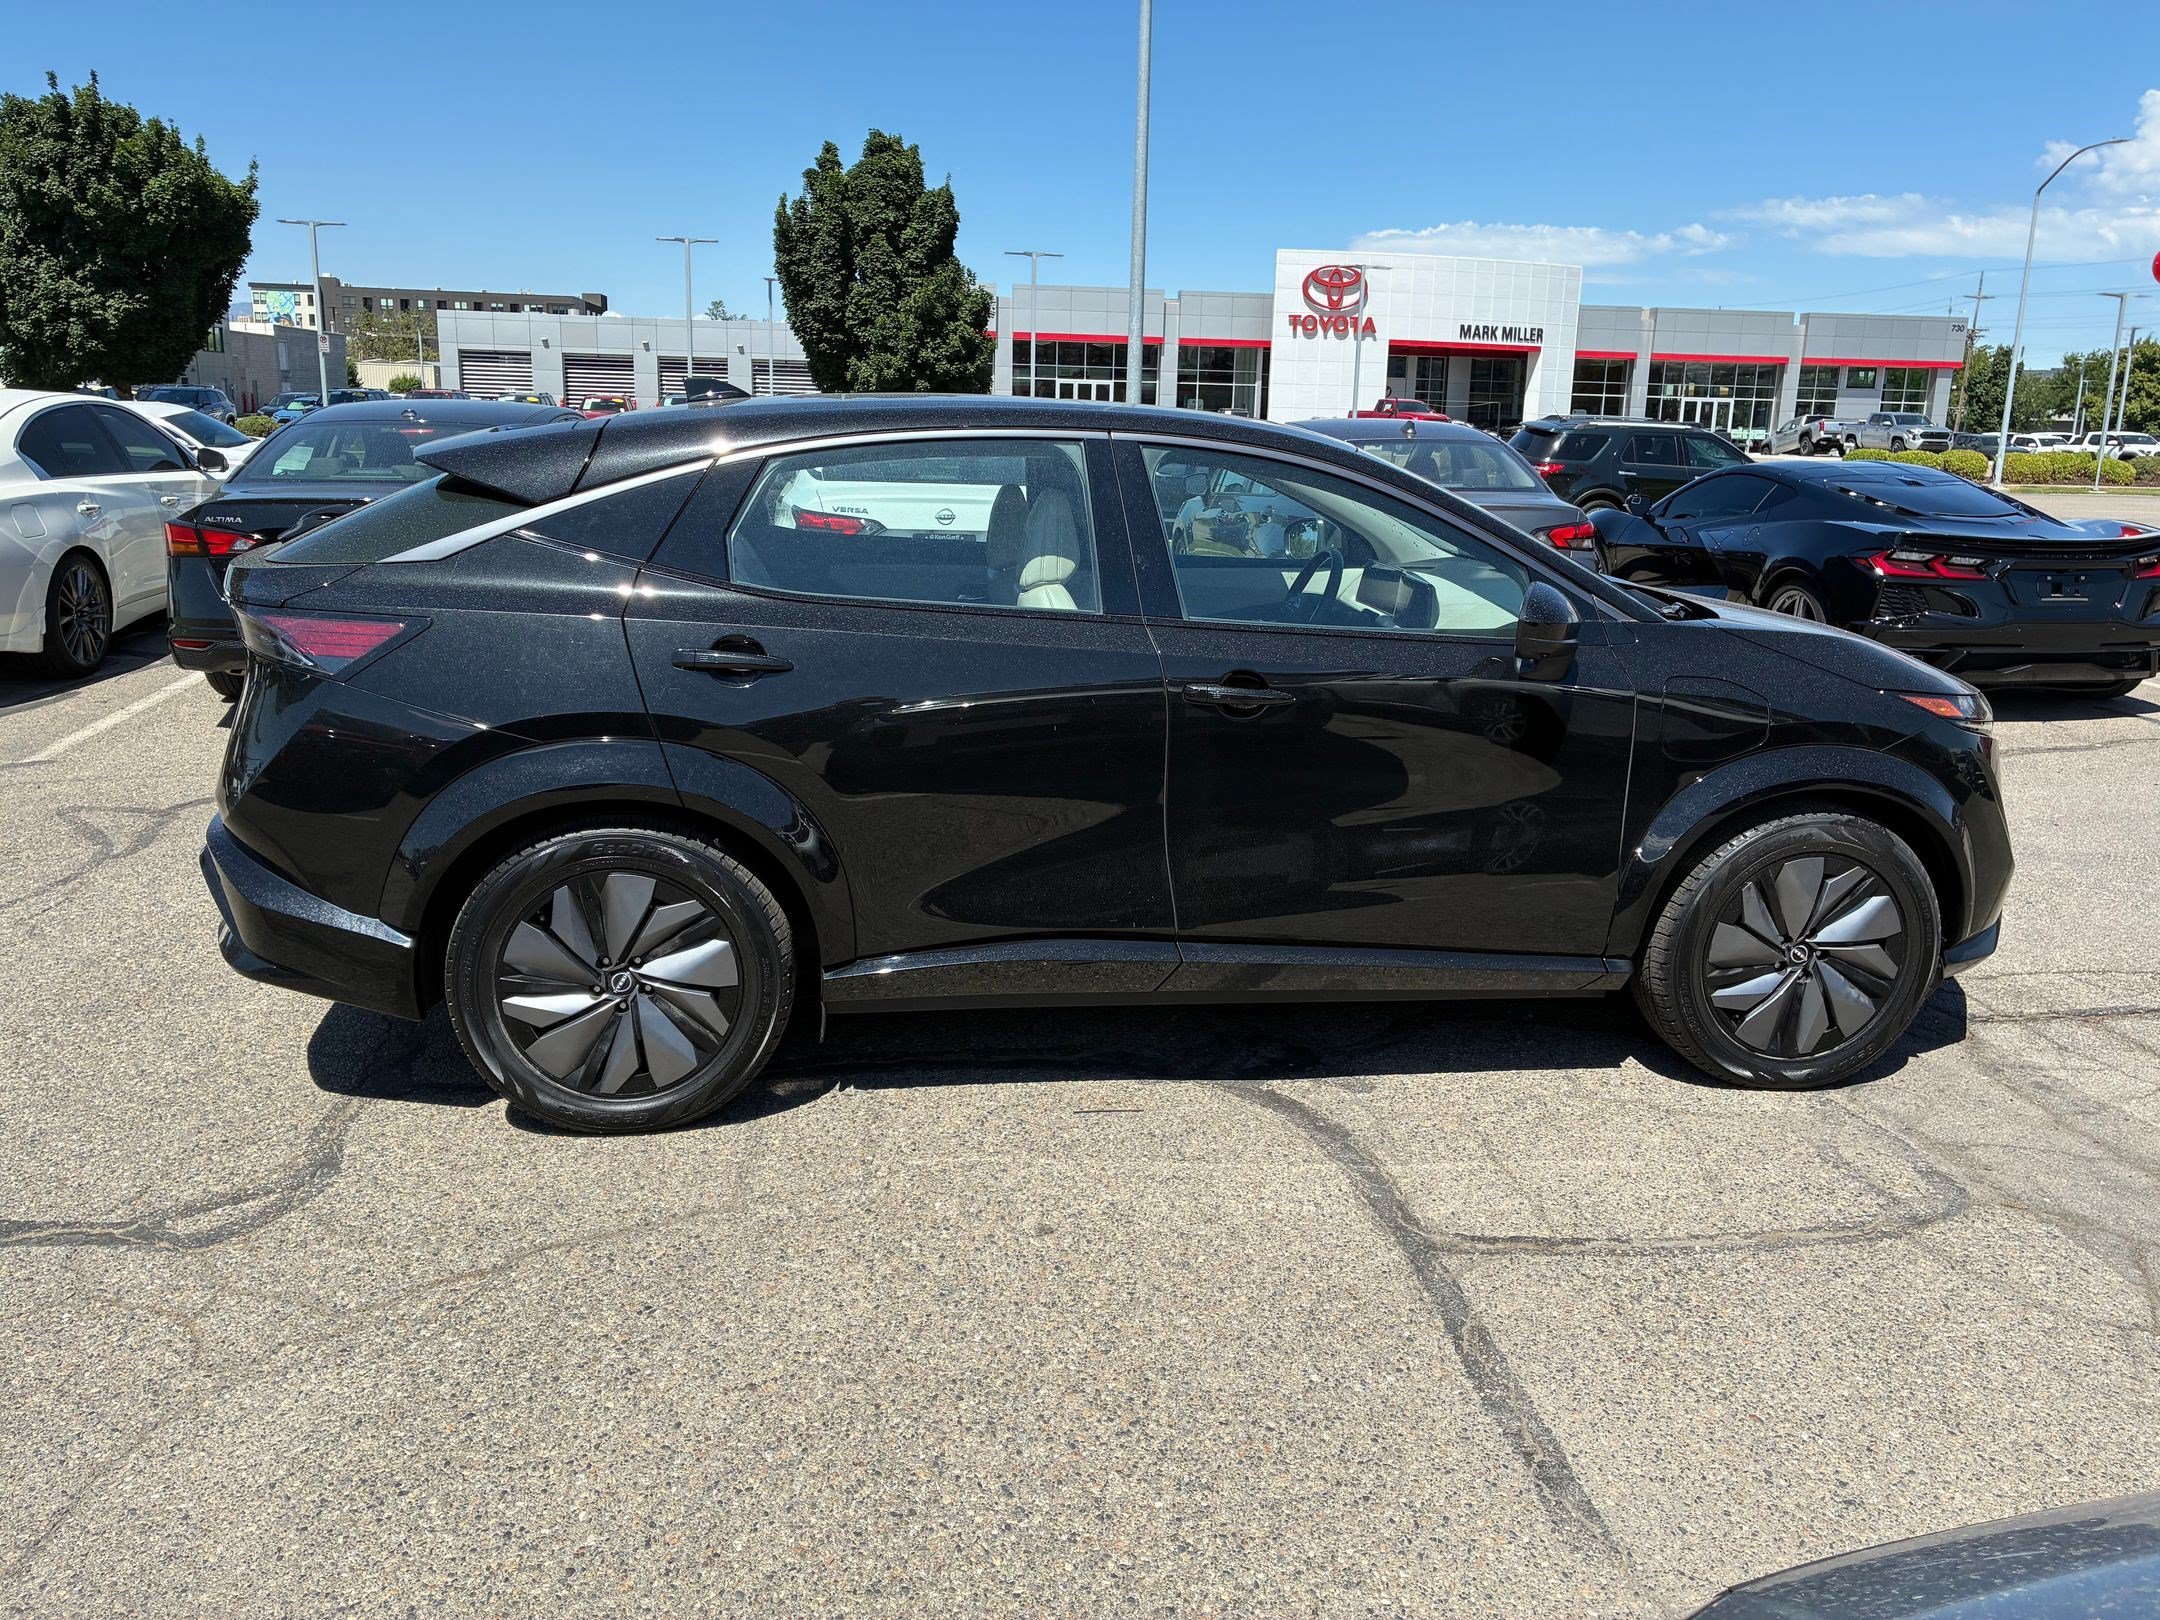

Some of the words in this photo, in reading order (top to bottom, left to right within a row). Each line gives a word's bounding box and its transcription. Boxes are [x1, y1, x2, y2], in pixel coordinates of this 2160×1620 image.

[1288, 314, 1377, 334] TOYOTA
[1951, 324, 1965, 333] 730
[1459, 324, 1499, 342] MARK
[1501, 326, 1544, 344] MILLER
[831, 505, 869, 515] VERSA
[203, 515, 243, 524] ALTIMA
